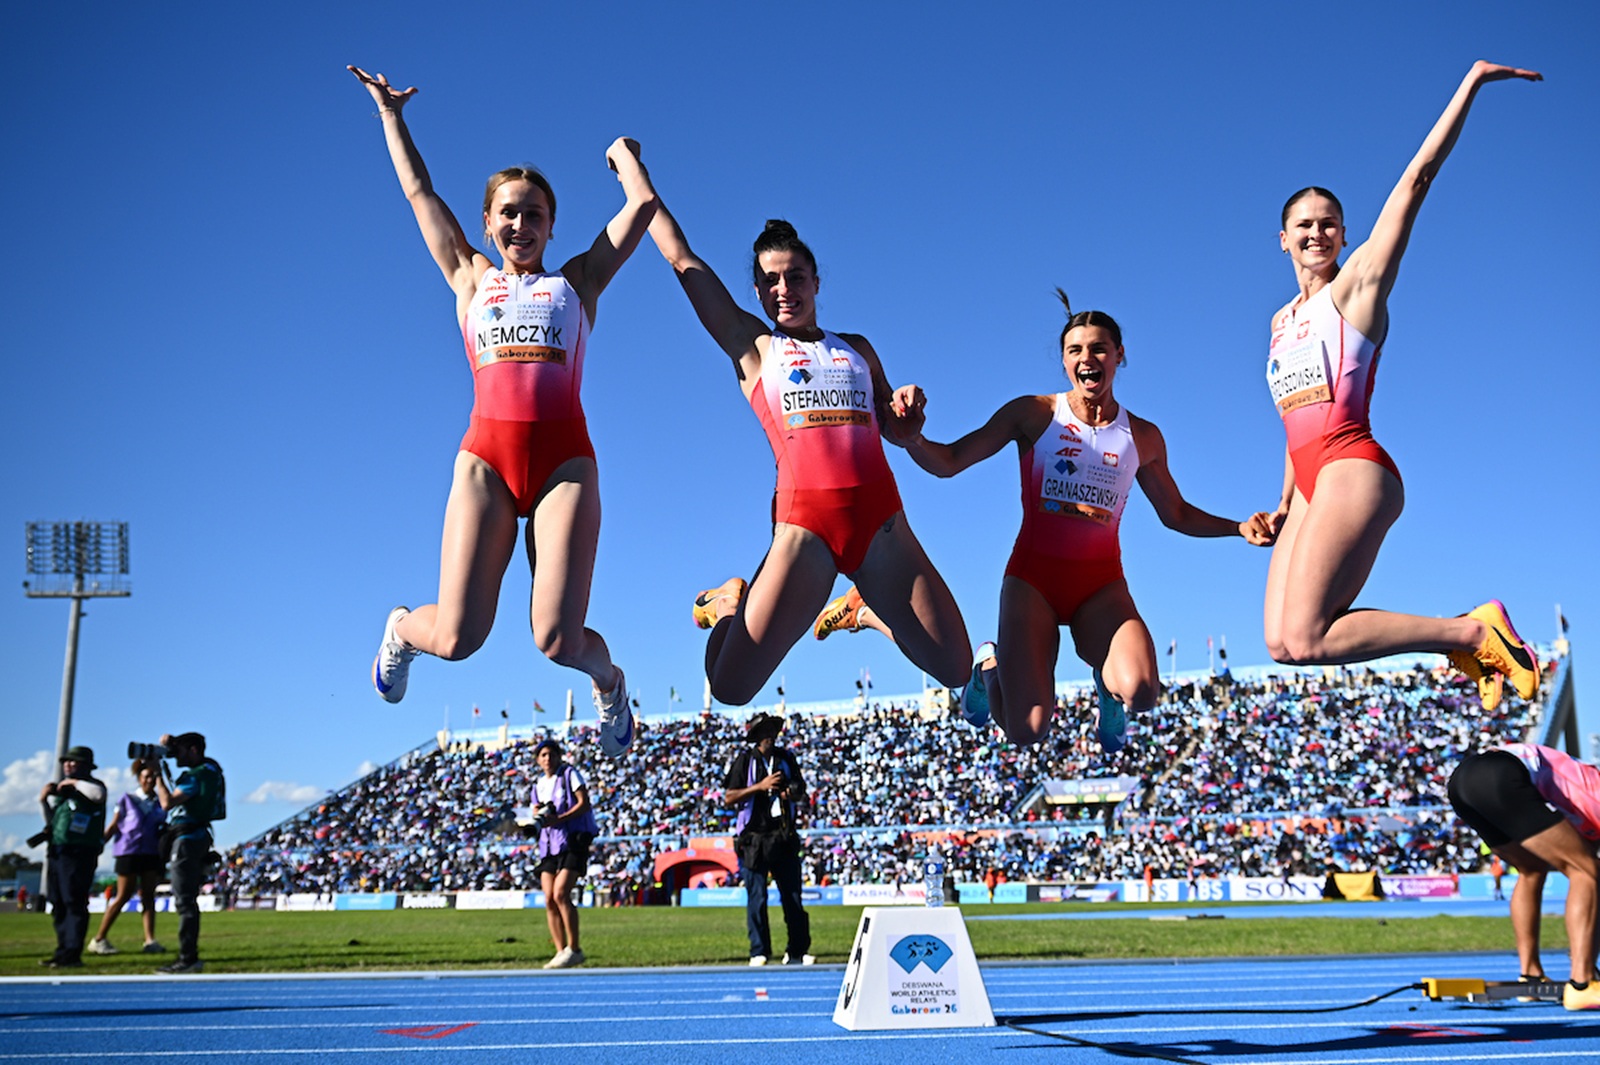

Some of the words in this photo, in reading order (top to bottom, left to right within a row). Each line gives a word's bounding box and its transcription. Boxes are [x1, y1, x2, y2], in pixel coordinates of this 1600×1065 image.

[478, 325, 563, 350] NIEMCZYK
[783, 389, 868, 411] STEFANOWICZ
[1059, 434, 1083, 444] ORLEN
[1086, 475, 1116, 485] COMPANY
[1135, 883, 1169, 901] TS
[918, 989, 957, 997] ATHLETICS
[891, 1004, 941, 1015] Gaborone
[944, 1003, 958, 1014] 26
